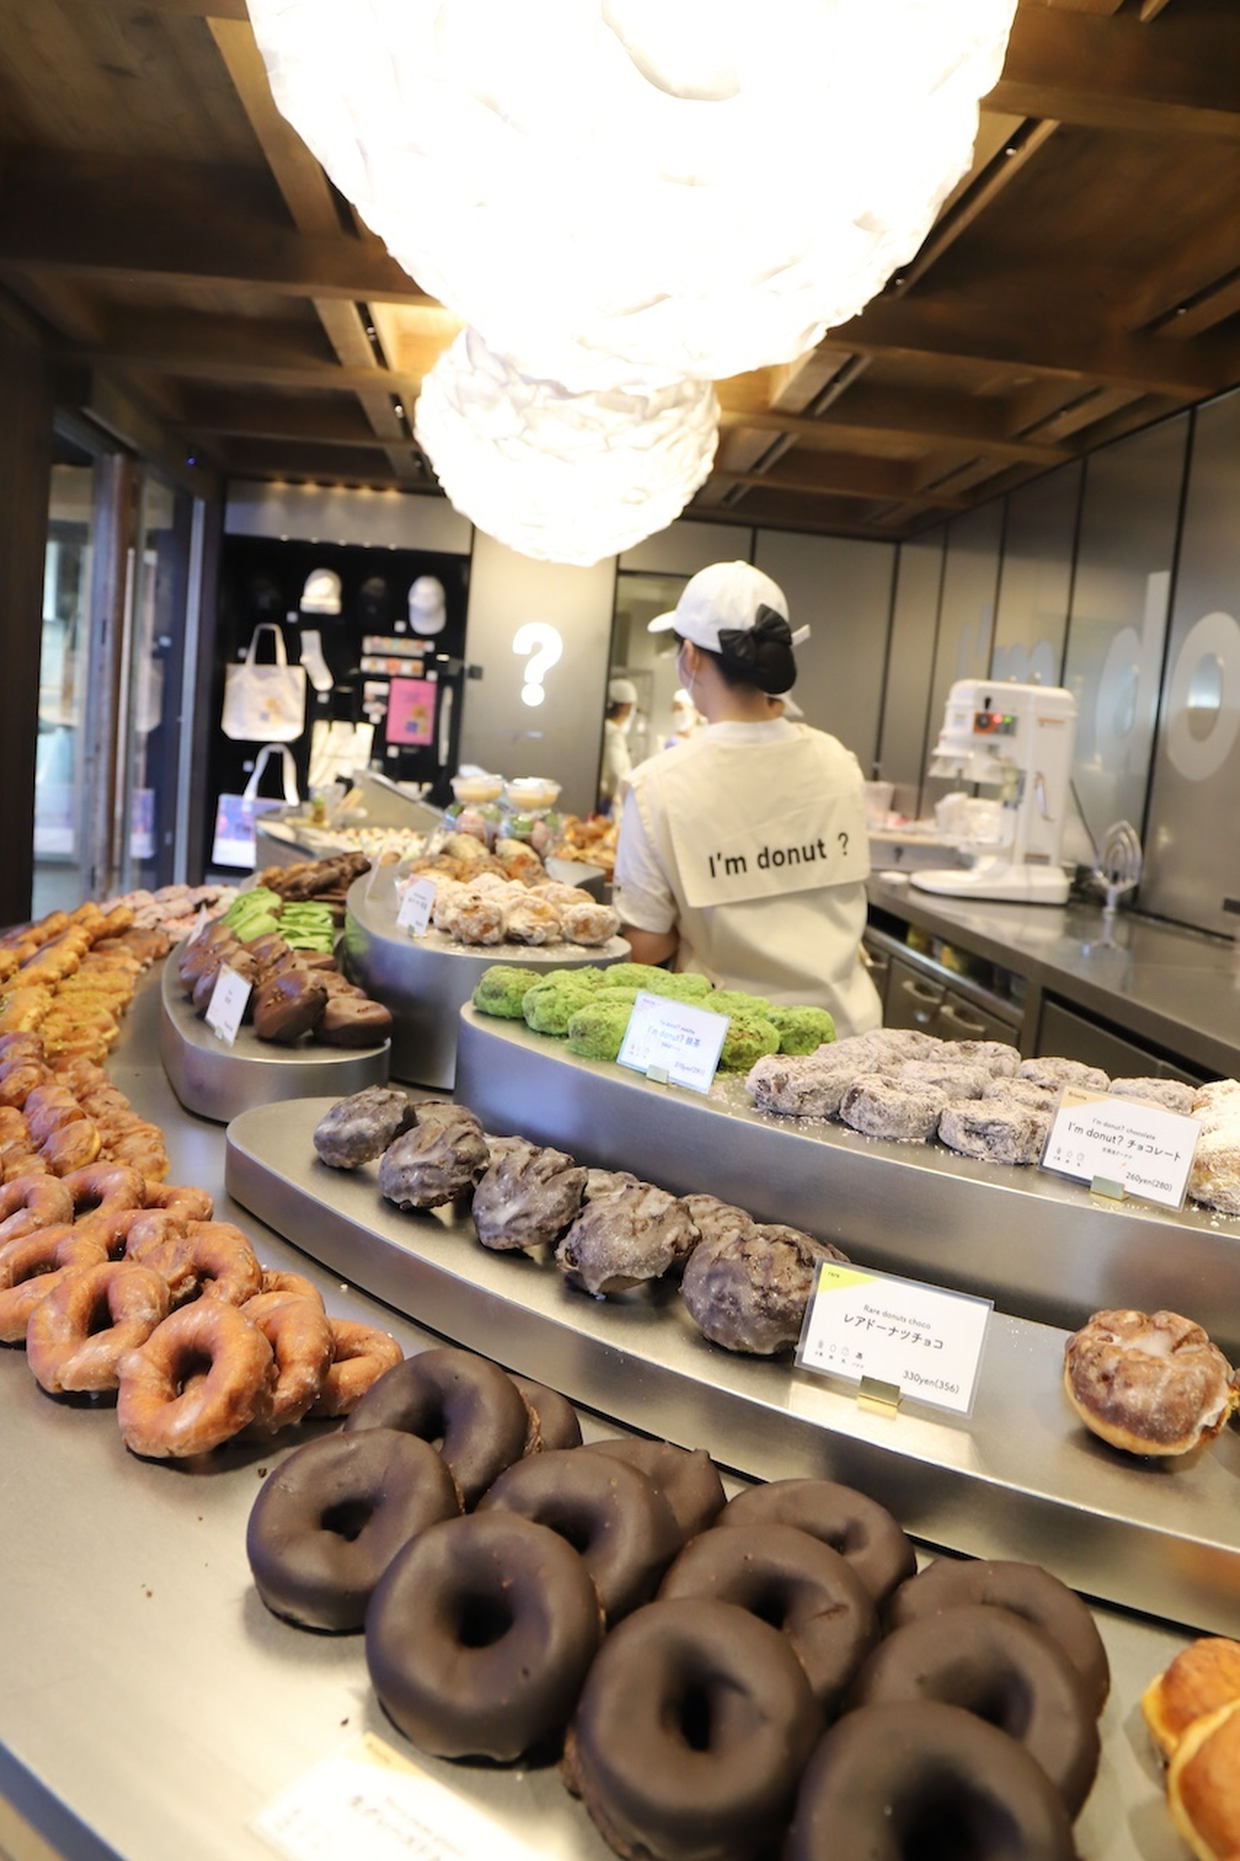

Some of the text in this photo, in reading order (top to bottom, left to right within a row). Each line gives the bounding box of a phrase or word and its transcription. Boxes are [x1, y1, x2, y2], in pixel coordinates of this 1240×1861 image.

[708, 832, 849, 878] I'm donut ?
[1067, 1121, 1084, 1135] I'm
[1086, 1127, 1124, 1145] donut?
[1127, 1139, 1181, 1162] チョコレート
[1103, 1120, 1125, 1131] donut?
[1126, 1128, 1156, 1141] chocolate
[1125, 1171, 1173, 1192] 260yen(280)
[863, 1304, 932, 1330] Rare donuts choco
[843, 1314, 944, 1350] レアドーナツチョコ
[902, 1370, 960, 1394] 330yen(356)
